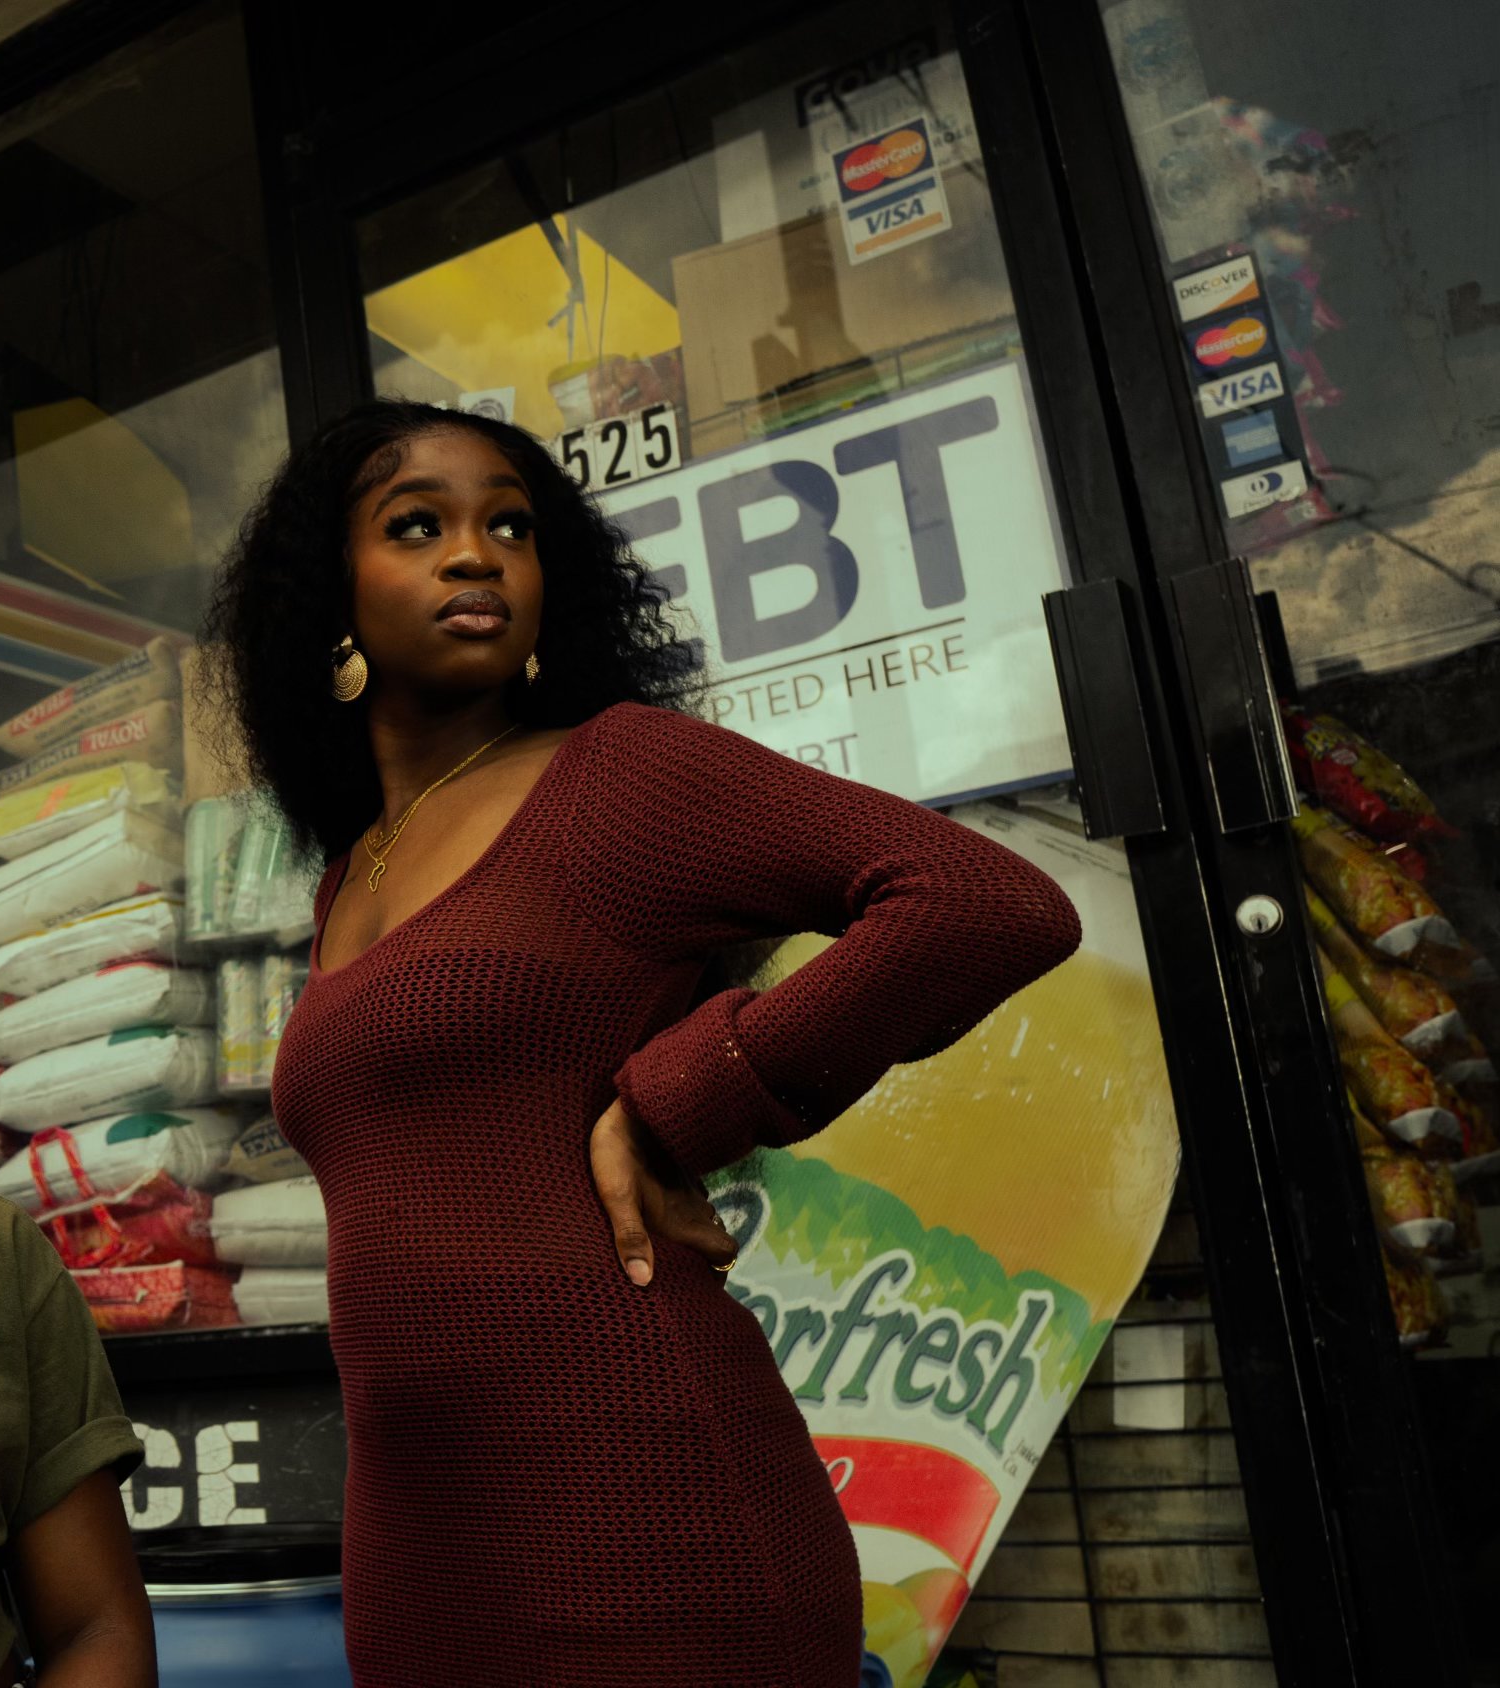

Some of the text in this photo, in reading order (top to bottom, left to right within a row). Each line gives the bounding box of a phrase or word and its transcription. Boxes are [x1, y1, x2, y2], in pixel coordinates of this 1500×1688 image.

[842, 141, 924, 181] MasterCard
[865, 198, 925, 234] VISA
[1180, 269, 1249, 299] DISCOVER
[1196, 326, 1265, 356] MasterCard
[1211, 372, 1278, 407] VISA
[562, 403, 672, 491] 525
[712, 634, 969, 725] PTED HERE
[90, 716, 148, 752] ROYAL
